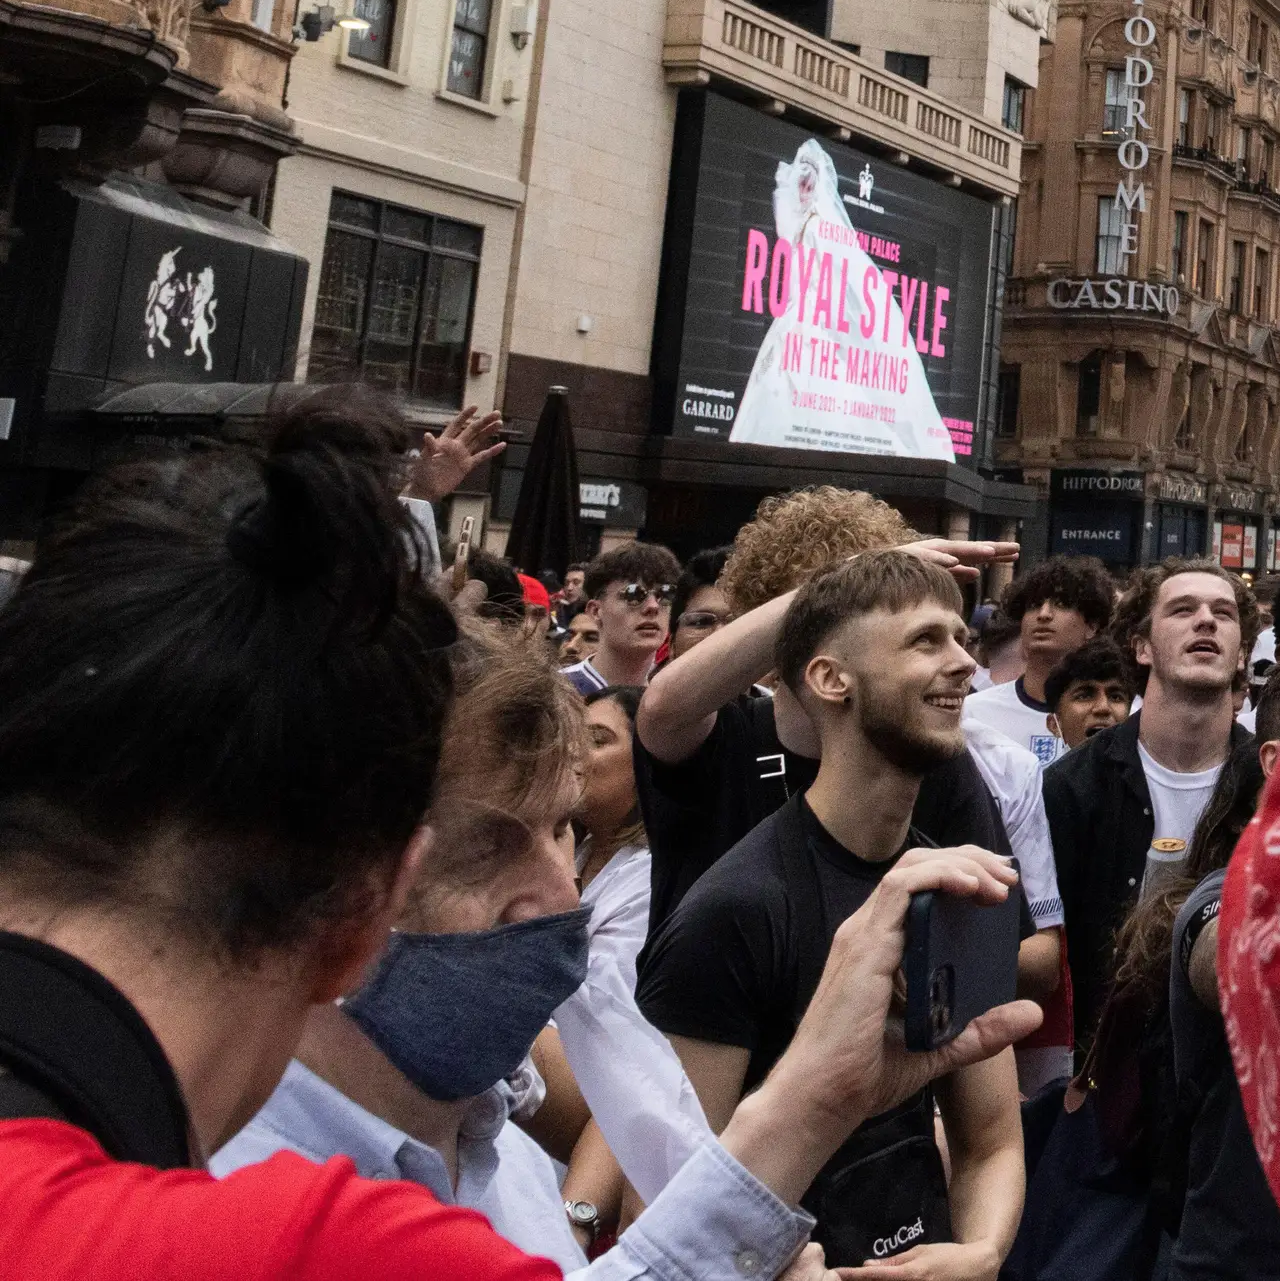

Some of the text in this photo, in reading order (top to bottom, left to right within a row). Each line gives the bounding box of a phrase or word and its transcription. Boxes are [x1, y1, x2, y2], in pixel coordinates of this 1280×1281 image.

[870, 236, 900, 263] PALACE
[741, 228, 951, 359] ROYAL STYLE
[1047, 279, 1180, 318] CASINO
[782, 332, 909, 395] IN THE MAKING
[683, 399, 735, 421] GARRARD
[1062, 528, 1121, 541] ENTRANCE
[872, 1216, 925, 1257] CruCast
